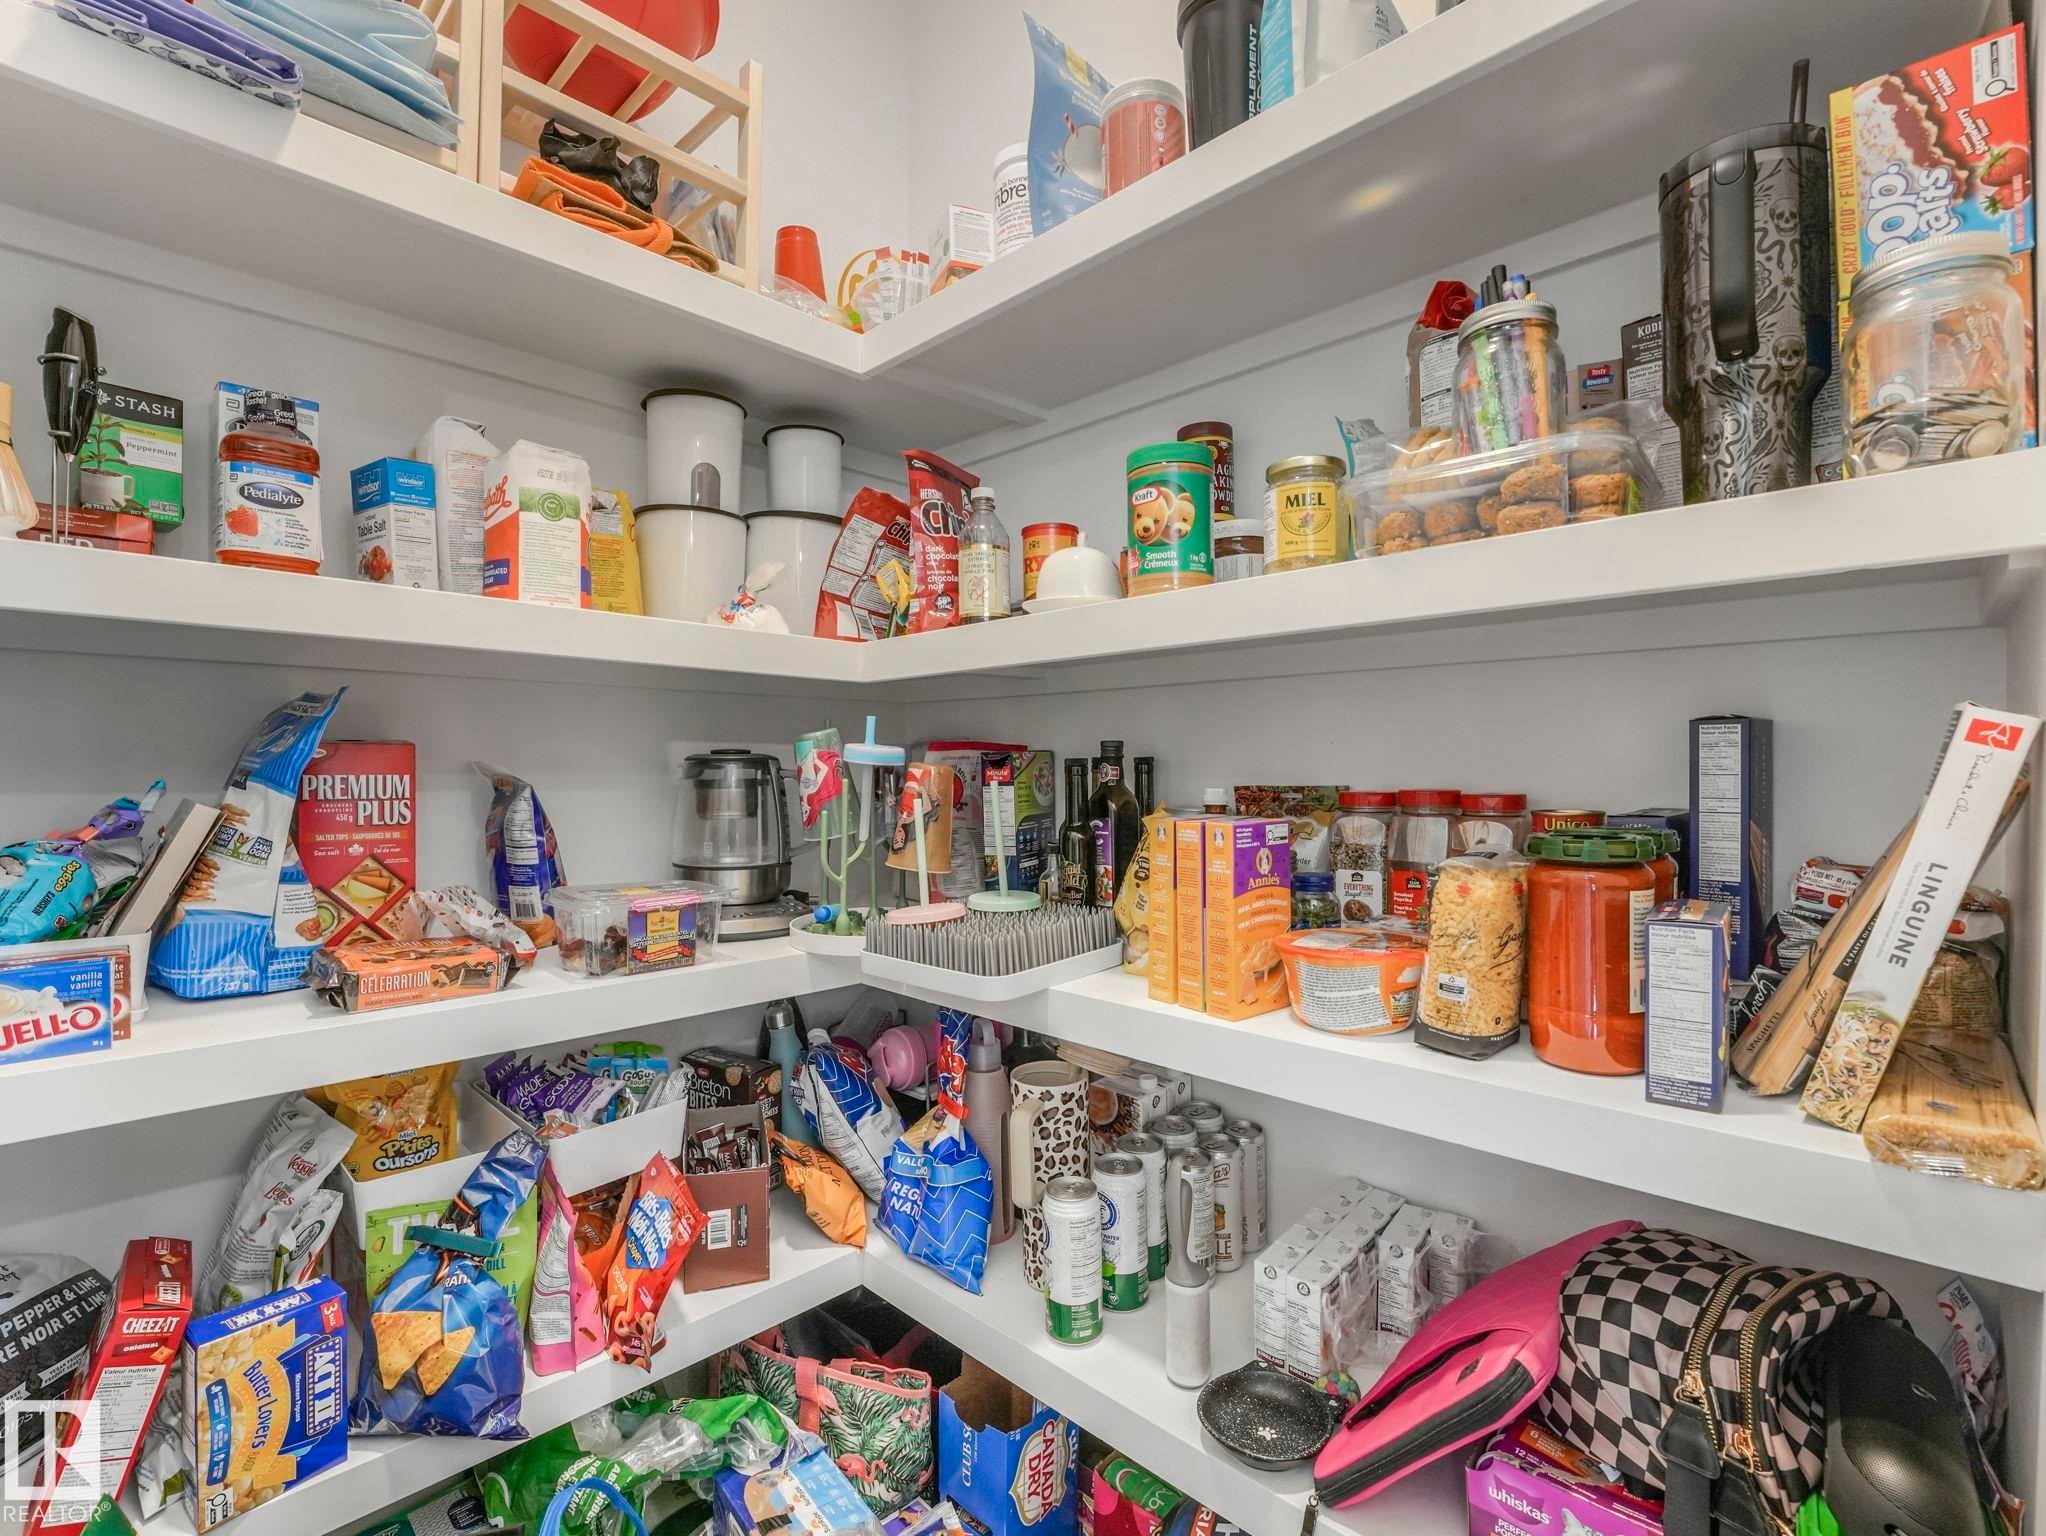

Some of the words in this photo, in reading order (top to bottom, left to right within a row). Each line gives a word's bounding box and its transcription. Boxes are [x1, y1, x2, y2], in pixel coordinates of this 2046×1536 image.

[1248, 24, 1258, 119] PPLEMENT
[1835, 115, 1852, 138] BON
[1837, 141, 1855, 197] FOLLEMENT
[1840, 209, 1855, 236] GOOD
[1638, 321, 1663, 337] KODI
[1591, 367, 1607, 376] Tasty
[1585, 377, 1611, 386] Rewards
[115, 395, 176, 419] STASH
[274, 409, 295, 419] Great
[126, 441, 177, 458] Peppermint
[357, 480, 381, 495] windsor
[398, 477, 424, 486] windsor
[243, 485, 303, 506] Pedialyte
[1134, 490, 1154, 503] Kraft
[1285, 492, 1326, 509] MIEL
[358, 522, 373, 537] Table
[374, 519, 387, 532] Salt
[925, 545, 945, 553] dark
[926, 552, 960, 560] chocolat
[1146, 550, 1177, 560] Smooth
[1144, 559, 1179, 569] Crémeux
[928, 582, 945, 592] noir
[986, 768, 1009, 776] Minute
[302, 774, 410, 801] PREMIUM
[336, 814, 348, 822] 450
[349, 815, 353, 824] g
[357, 800, 412, 827] PLUS
[220, 826, 236, 836] NON
[315, 833, 335, 841] SALTED
[250, 848, 270, 860] OGM
[254, 842, 271, 854] SANS
[54, 860, 81, 892] eggies
[1248, 873, 1281, 891] Annie's
[1344, 882, 1374, 892] EVERYTHING
[1888, 862, 1949, 969] LINGUINE
[1650, 926, 1677, 934] Nutrition
[1650, 932, 1670, 940] Valeur
[1670, 933, 1697, 941] nutritive
[1843, 956, 1852, 968] LA
[1849, 938, 1865, 960] PASTA
[70, 971, 103, 982] vanilla
[70, 980, 103, 990] vanille
[0, 1005, 102, 1052] JELL-O
[1746, 1010, 1781, 1053] SPAGHETTI
[690, 1072, 732, 1101] Breton
[689, 1090, 718, 1109] BITES
[399, 1129, 417, 1141] Miel
[380, 1135, 434, 1157] P'tits
[374, 1142, 440, 1172] Oursons
[898, 1154, 926, 1167] VALU
[287, 1154, 318, 1179] Veggie
[639, 1190, 660, 1219] Bits
[654, 1212, 673, 1250] Bites
[627, 1207, 660, 1269] Méli-Mélo
[486, 1258, 506, 1271] DILL
[0, 1294, 64, 1338] PEPPER
[62, 1287, 76, 1303] &
[77, 1275, 101, 1296] LIME
[323, 1302, 339, 1316] 3
[20, 1320, 64, 1352] NOIR
[65, 1309, 82, 1327] ET
[49, 1363, 67, 1376] VEGAN
[68, 1351, 88, 1366] PRODU
[1256, 1348, 1285, 1367] KIRKLAND
[103, 1368, 127, 1377] Valeur
[242, 1359, 272, 1401] Butter
[313, 1350, 336, 1392] ACT
[251, 1400, 272, 1449] Lovers
[1529, 1430, 1539, 1438] 6
[1514, 1446, 1527, 1459] 12
[961, 1442, 973, 1487] CLUB
[1040, 1419, 1057, 1520] CANADA
[1027, 1453, 1042, 1499] DRY
[1488, 1483, 1551, 1526] whiskas
[1498, 1518, 1534, 1536] PERFE
